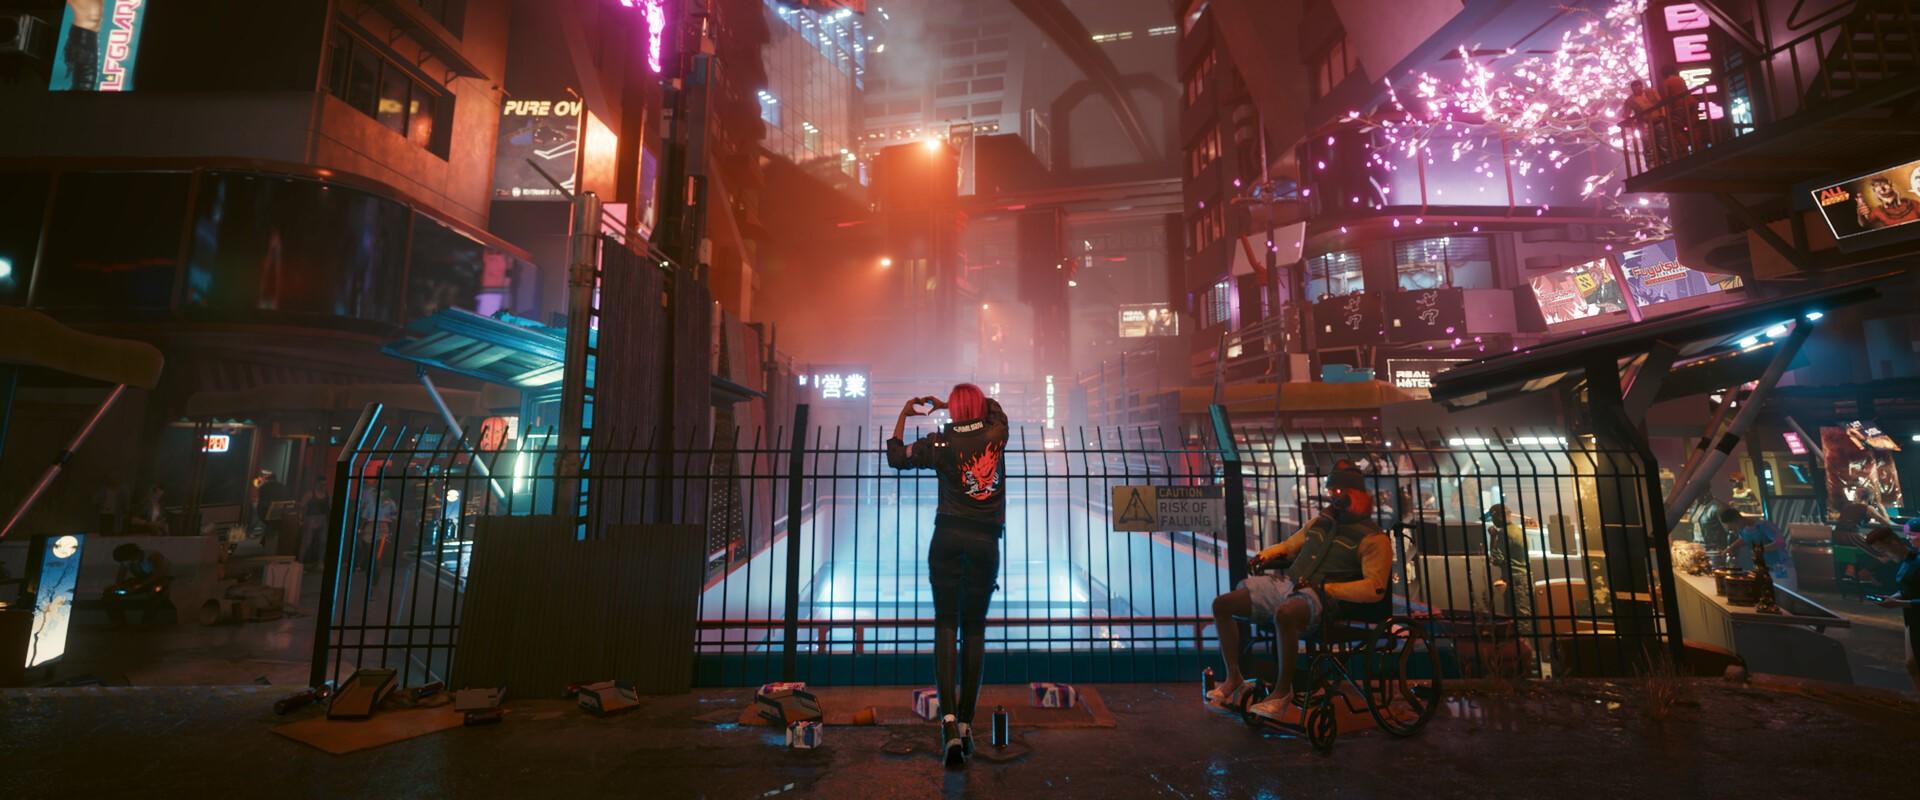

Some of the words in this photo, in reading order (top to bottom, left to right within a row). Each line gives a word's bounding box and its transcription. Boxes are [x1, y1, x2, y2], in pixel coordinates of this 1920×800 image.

[503, 100, 551, 116] PURE
[1820, 185, 1847, 200] ALL
[1396, 370, 1430, 378] REAL
[207, 437, 227, 450] PEN
[1159, 487, 1203, 497] CAUTION
[1160, 502, 1188, 513] RISK
[1192, 502, 1208, 513] OF
[1160, 515, 1211, 527] FALLING
